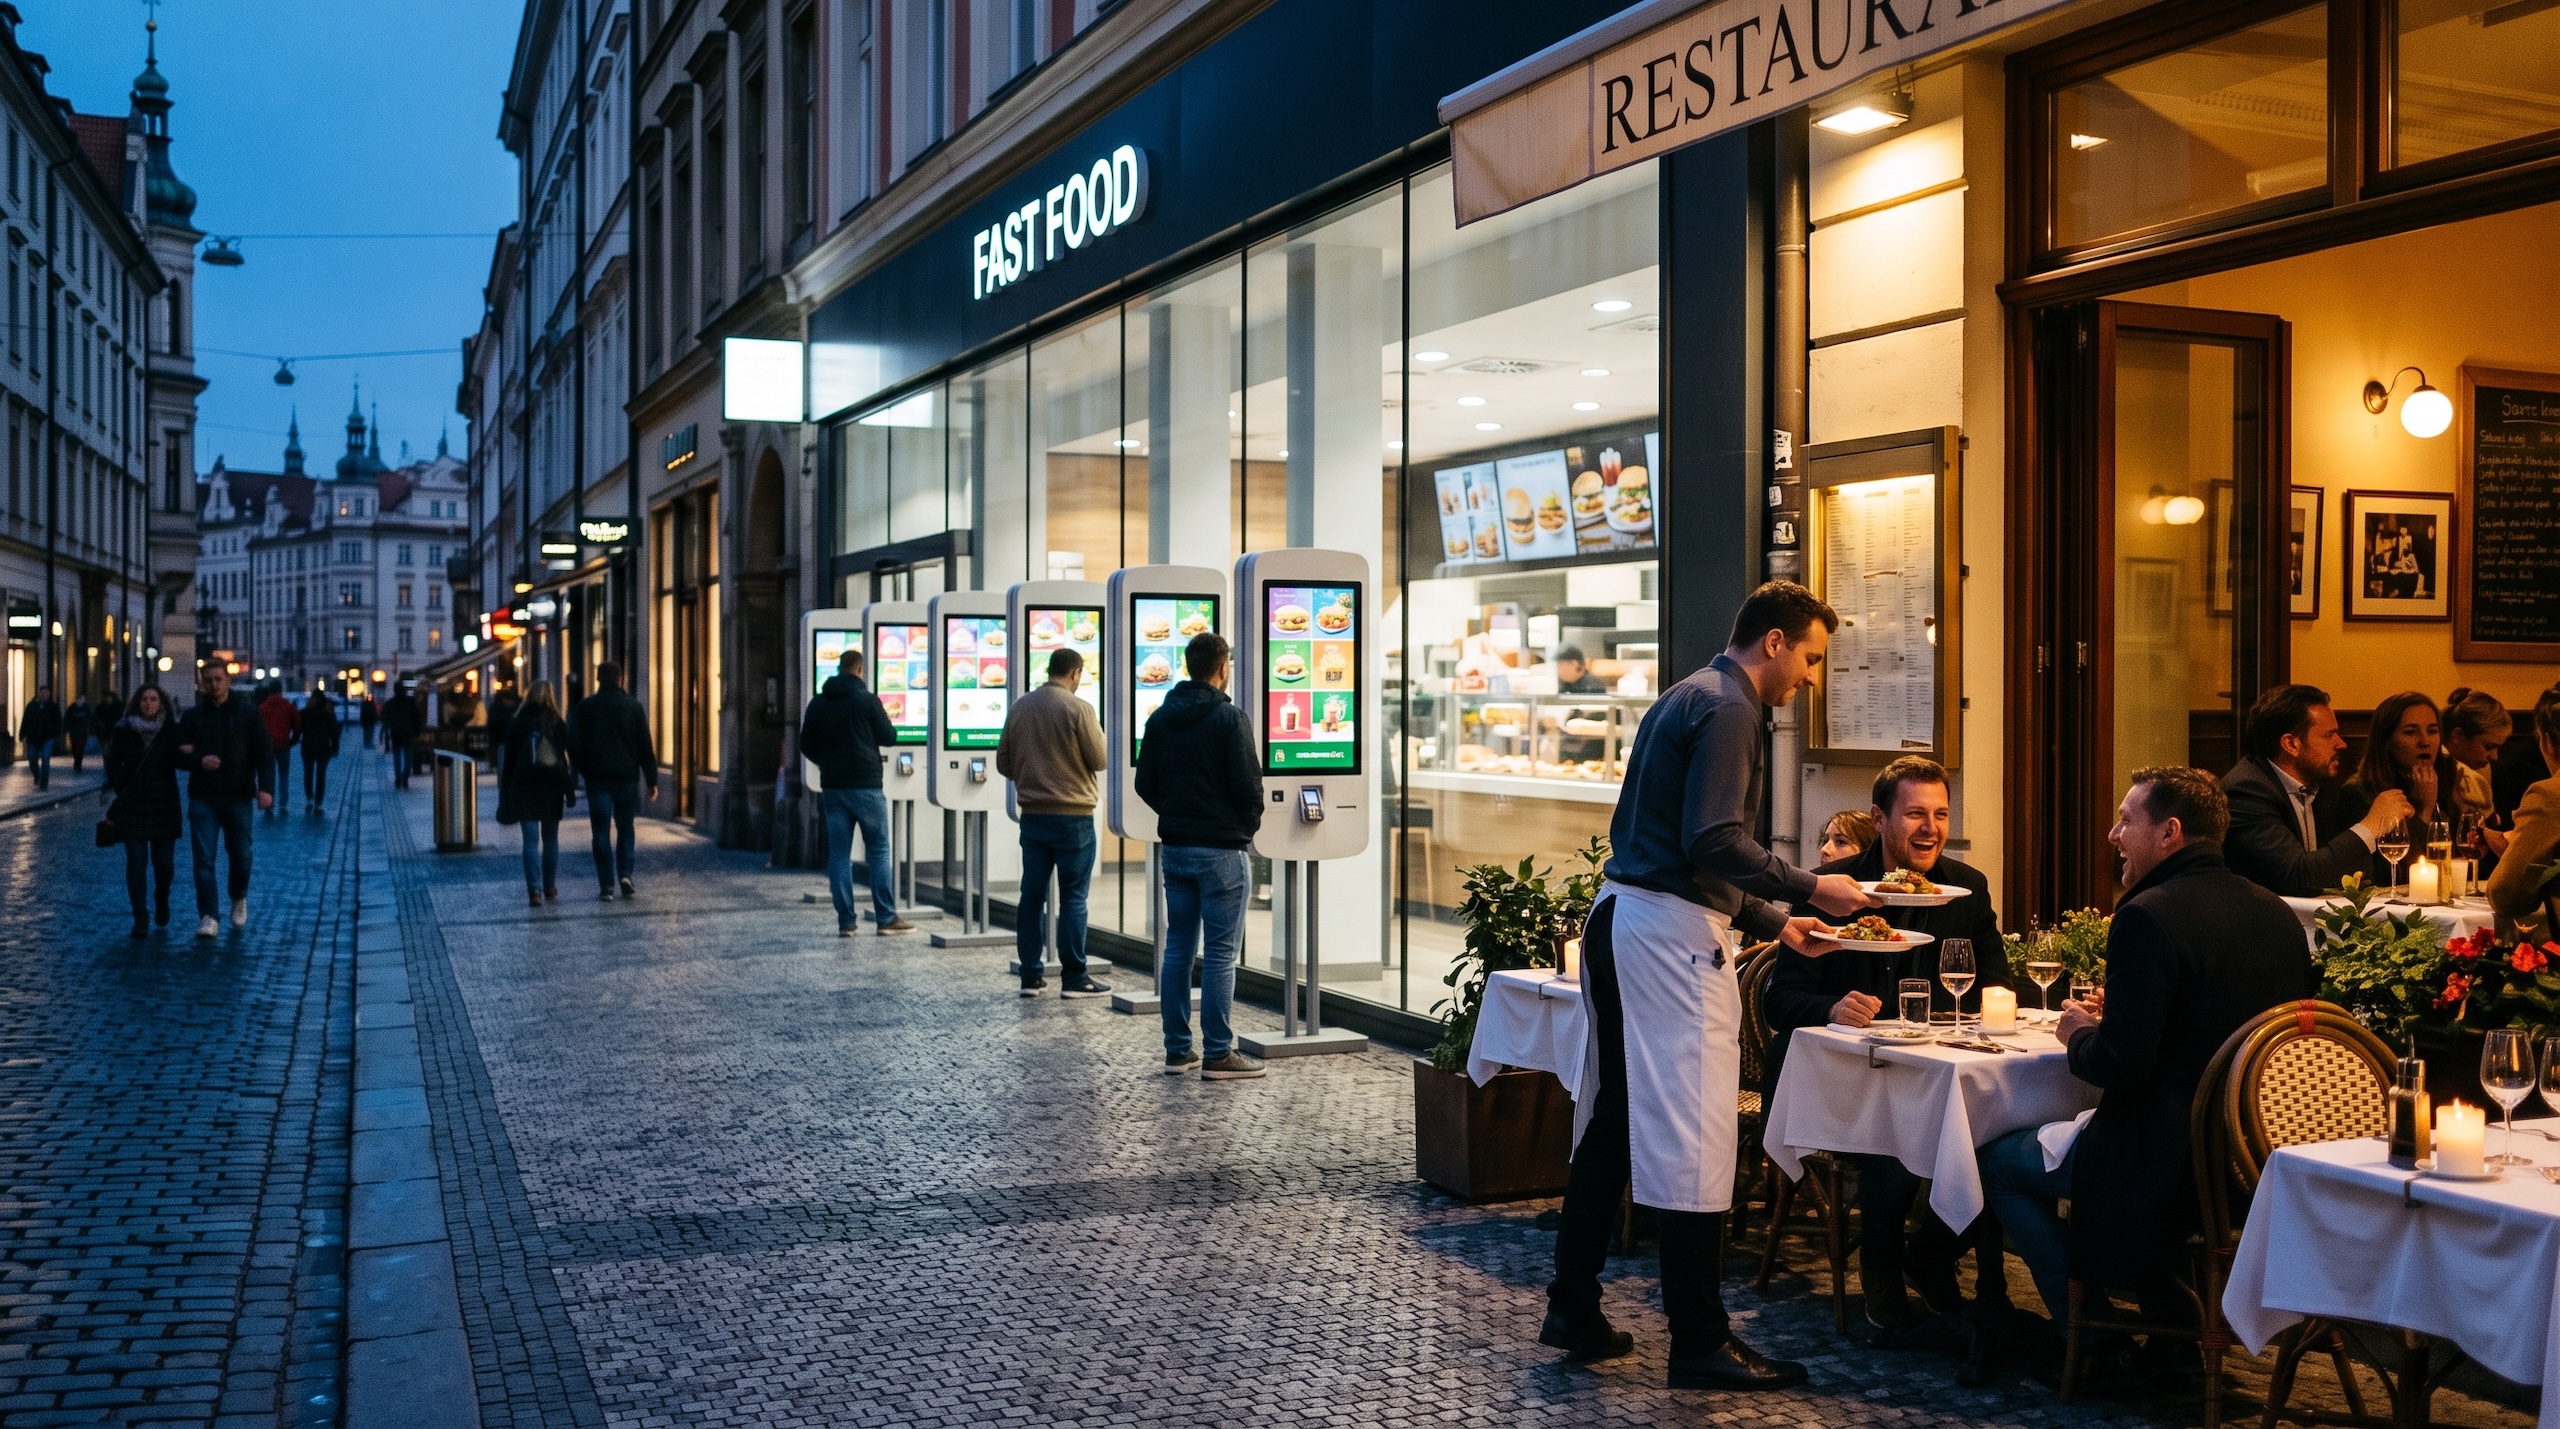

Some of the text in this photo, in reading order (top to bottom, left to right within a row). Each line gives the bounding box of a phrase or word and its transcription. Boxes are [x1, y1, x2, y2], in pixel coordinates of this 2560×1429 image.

[1601, 0, 2004, 155] RESTAUR
[974, 144, 1138, 300] FAST FOOD
